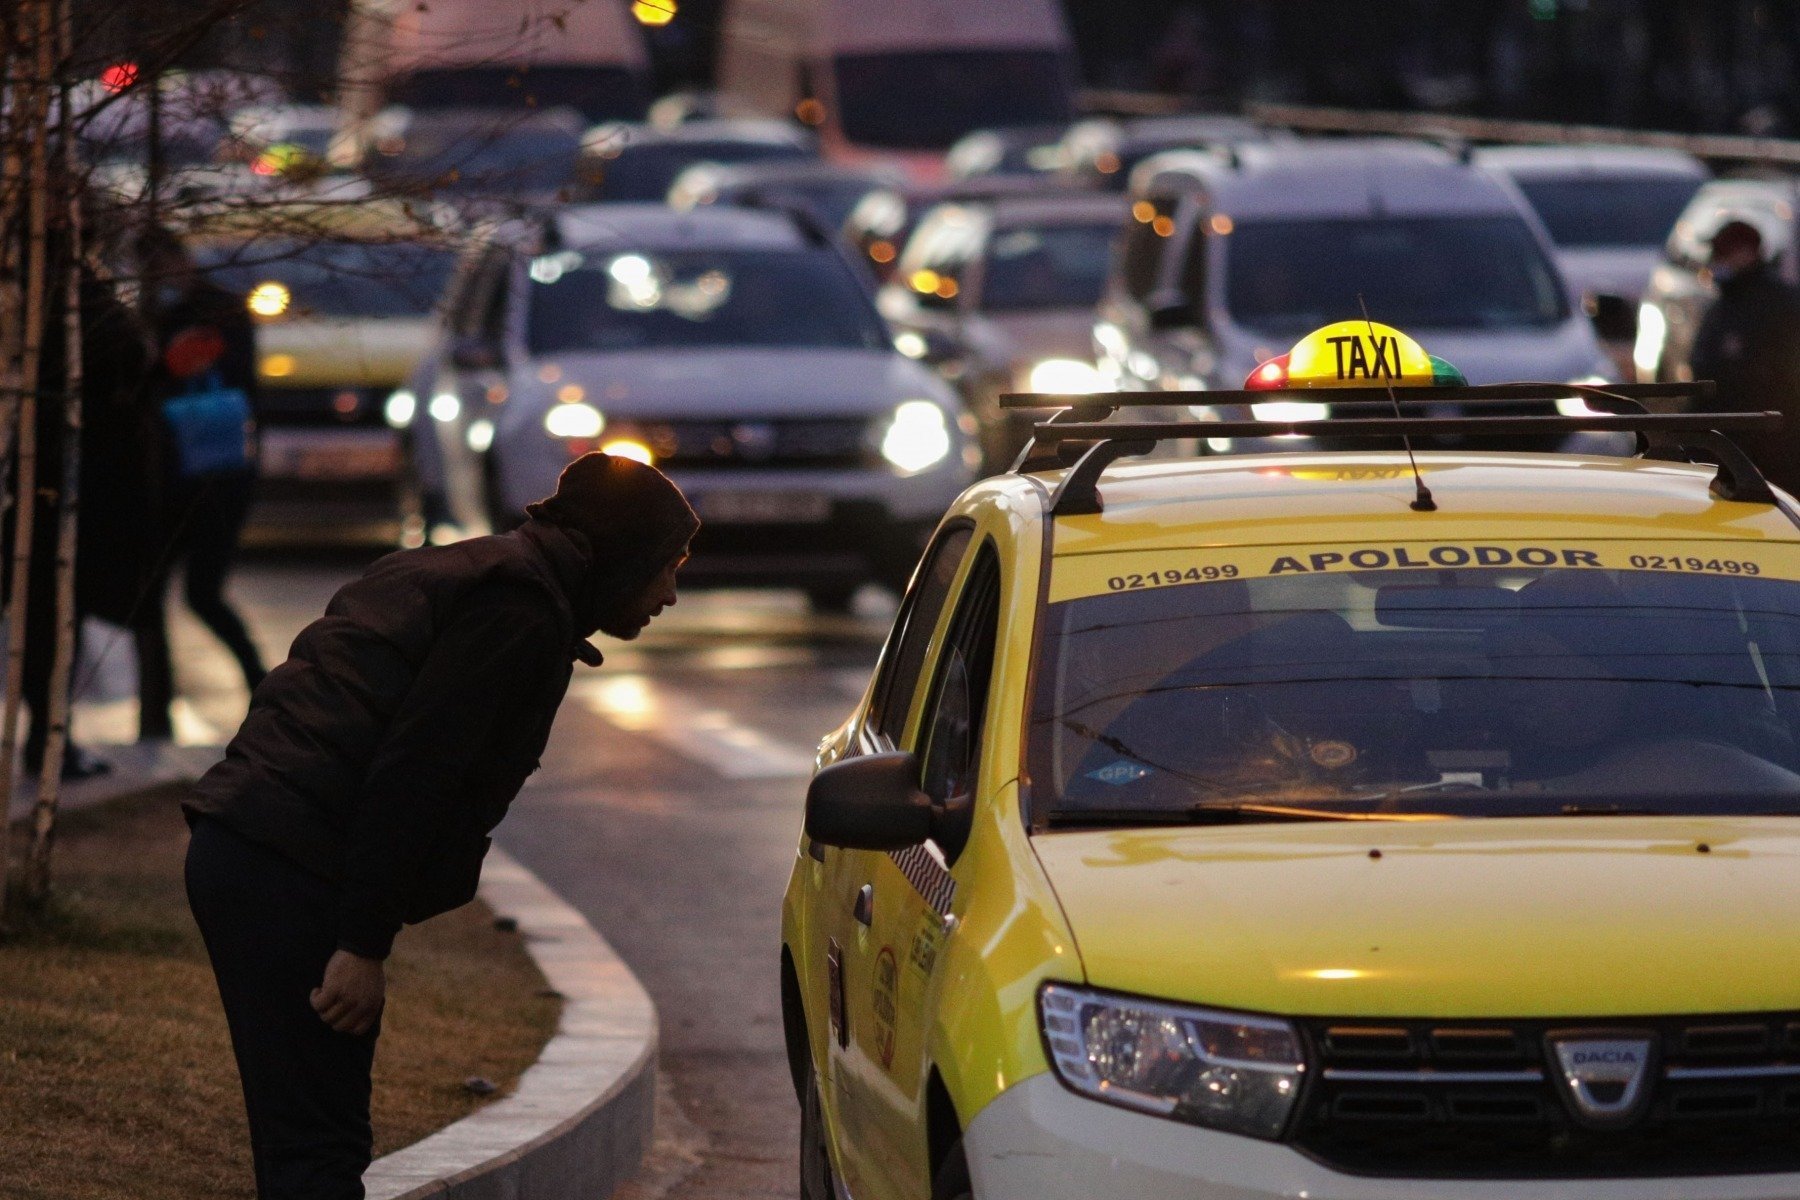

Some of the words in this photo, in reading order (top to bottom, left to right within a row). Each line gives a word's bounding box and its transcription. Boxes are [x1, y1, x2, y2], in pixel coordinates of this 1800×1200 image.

[1326, 335, 1403, 380] TAXI
[1107, 564, 1240, 591] 0219499
[1269, 546, 1603, 574] APOLODOR
[1628, 555, 1761, 576] 0219499
[1573, 1052, 1636, 1064] DACIA
